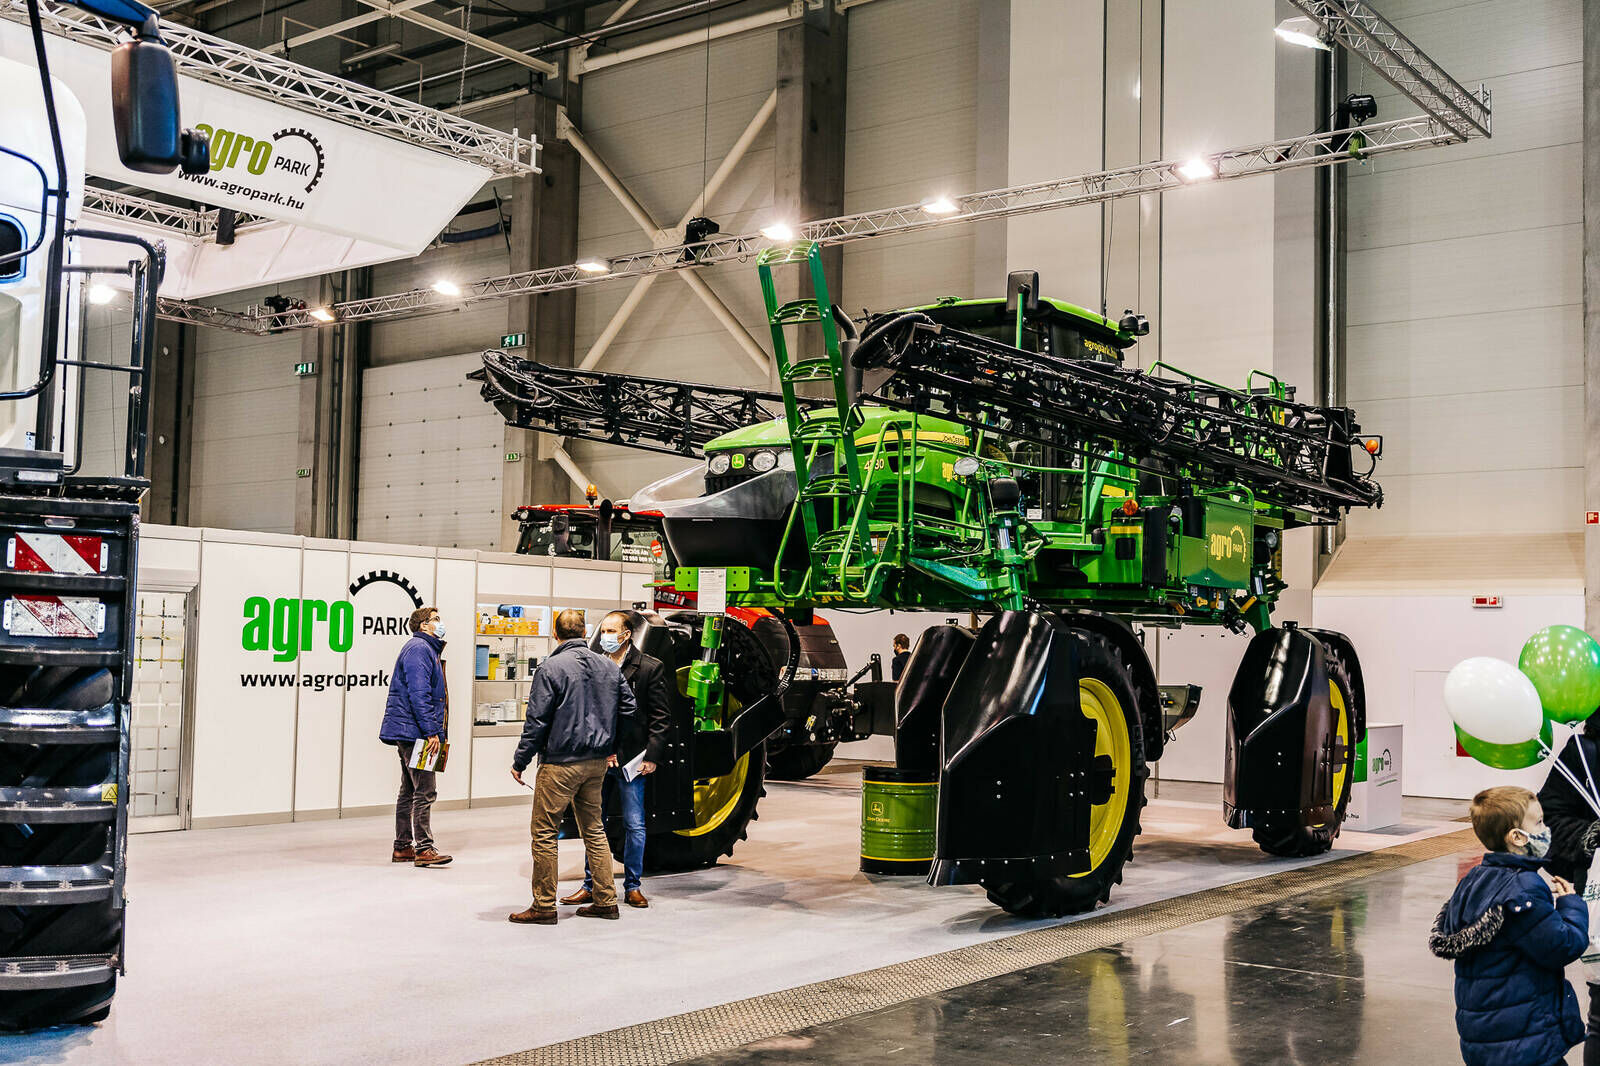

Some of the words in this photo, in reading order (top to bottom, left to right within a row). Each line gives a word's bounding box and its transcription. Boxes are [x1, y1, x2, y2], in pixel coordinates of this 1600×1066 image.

[274, 156, 311, 176] PARK
[178, 167, 305, 209] www.agropark.hu
[864, 458, 885, 471] 430
[1211, 534, 1231, 560] agro
[242, 596, 354, 662] agro
[362, 616, 410, 635] PARK
[241, 670, 389, 691] www.agropark
